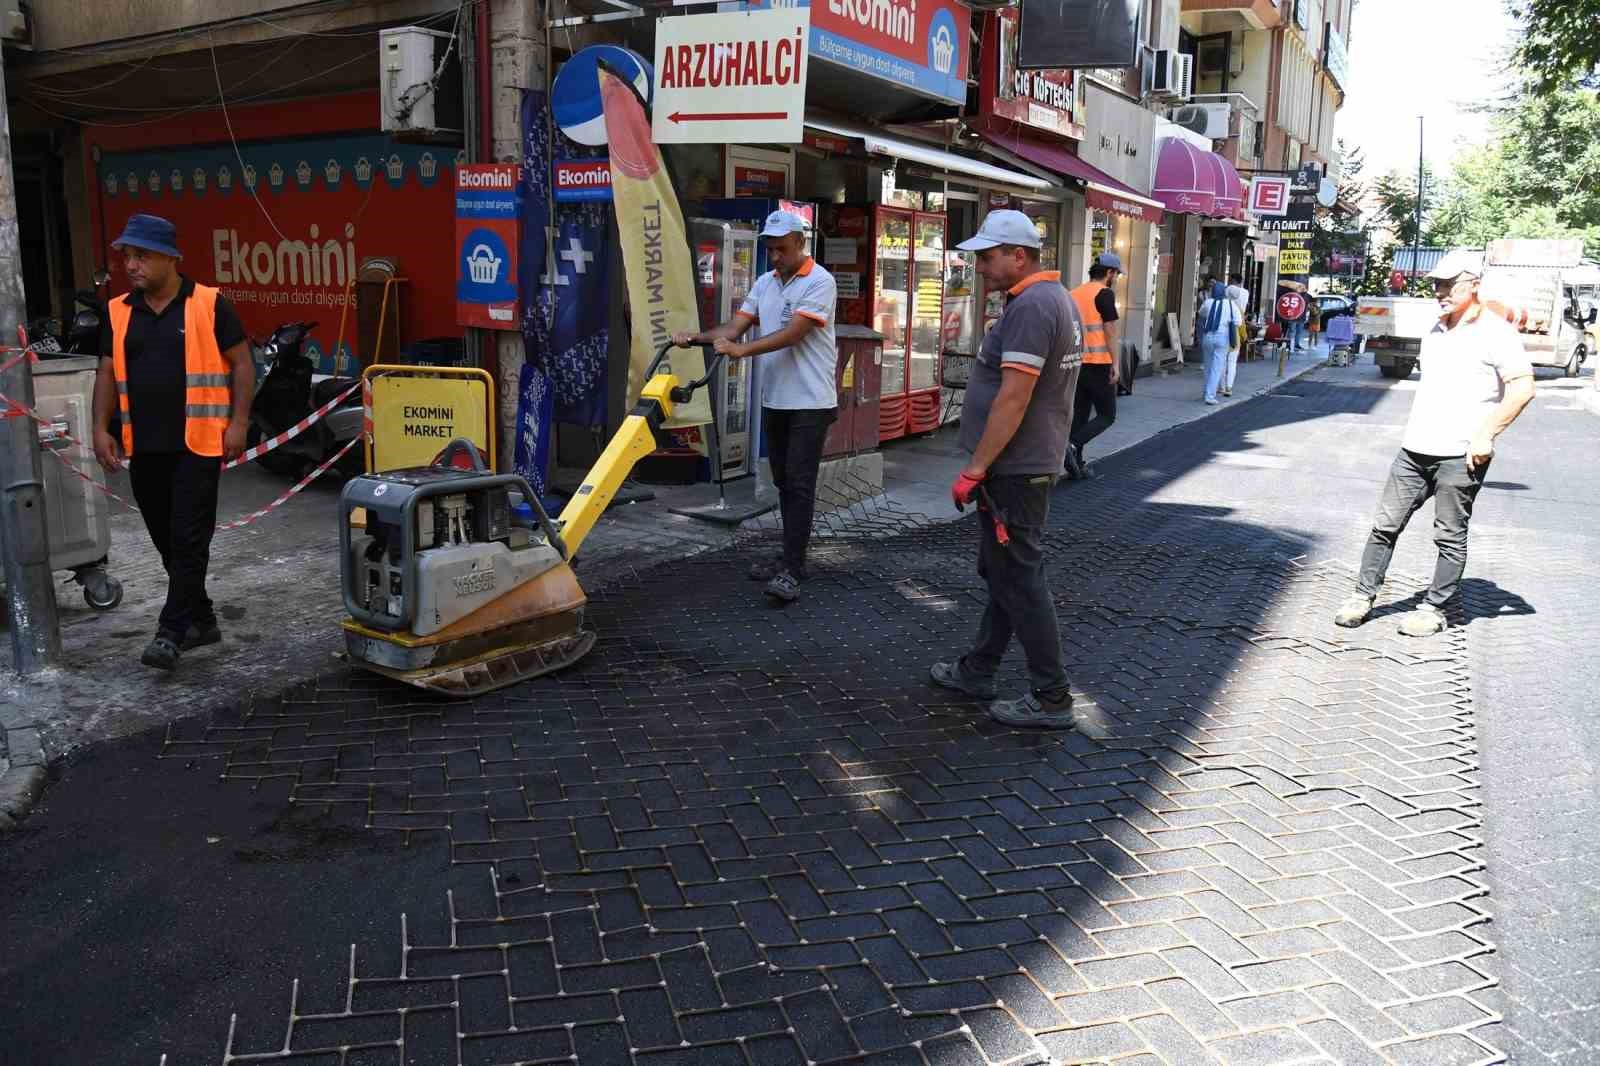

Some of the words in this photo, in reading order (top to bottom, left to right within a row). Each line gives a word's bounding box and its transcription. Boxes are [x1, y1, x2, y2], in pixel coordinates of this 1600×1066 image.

[458, 169, 513, 187] Ekomini
[558, 166, 613, 185] Ekomin
[212, 222, 357, 287] Ekomini
[1282, 296, 1299, 308] 35
[404, 424, 454, 438] MARKET
